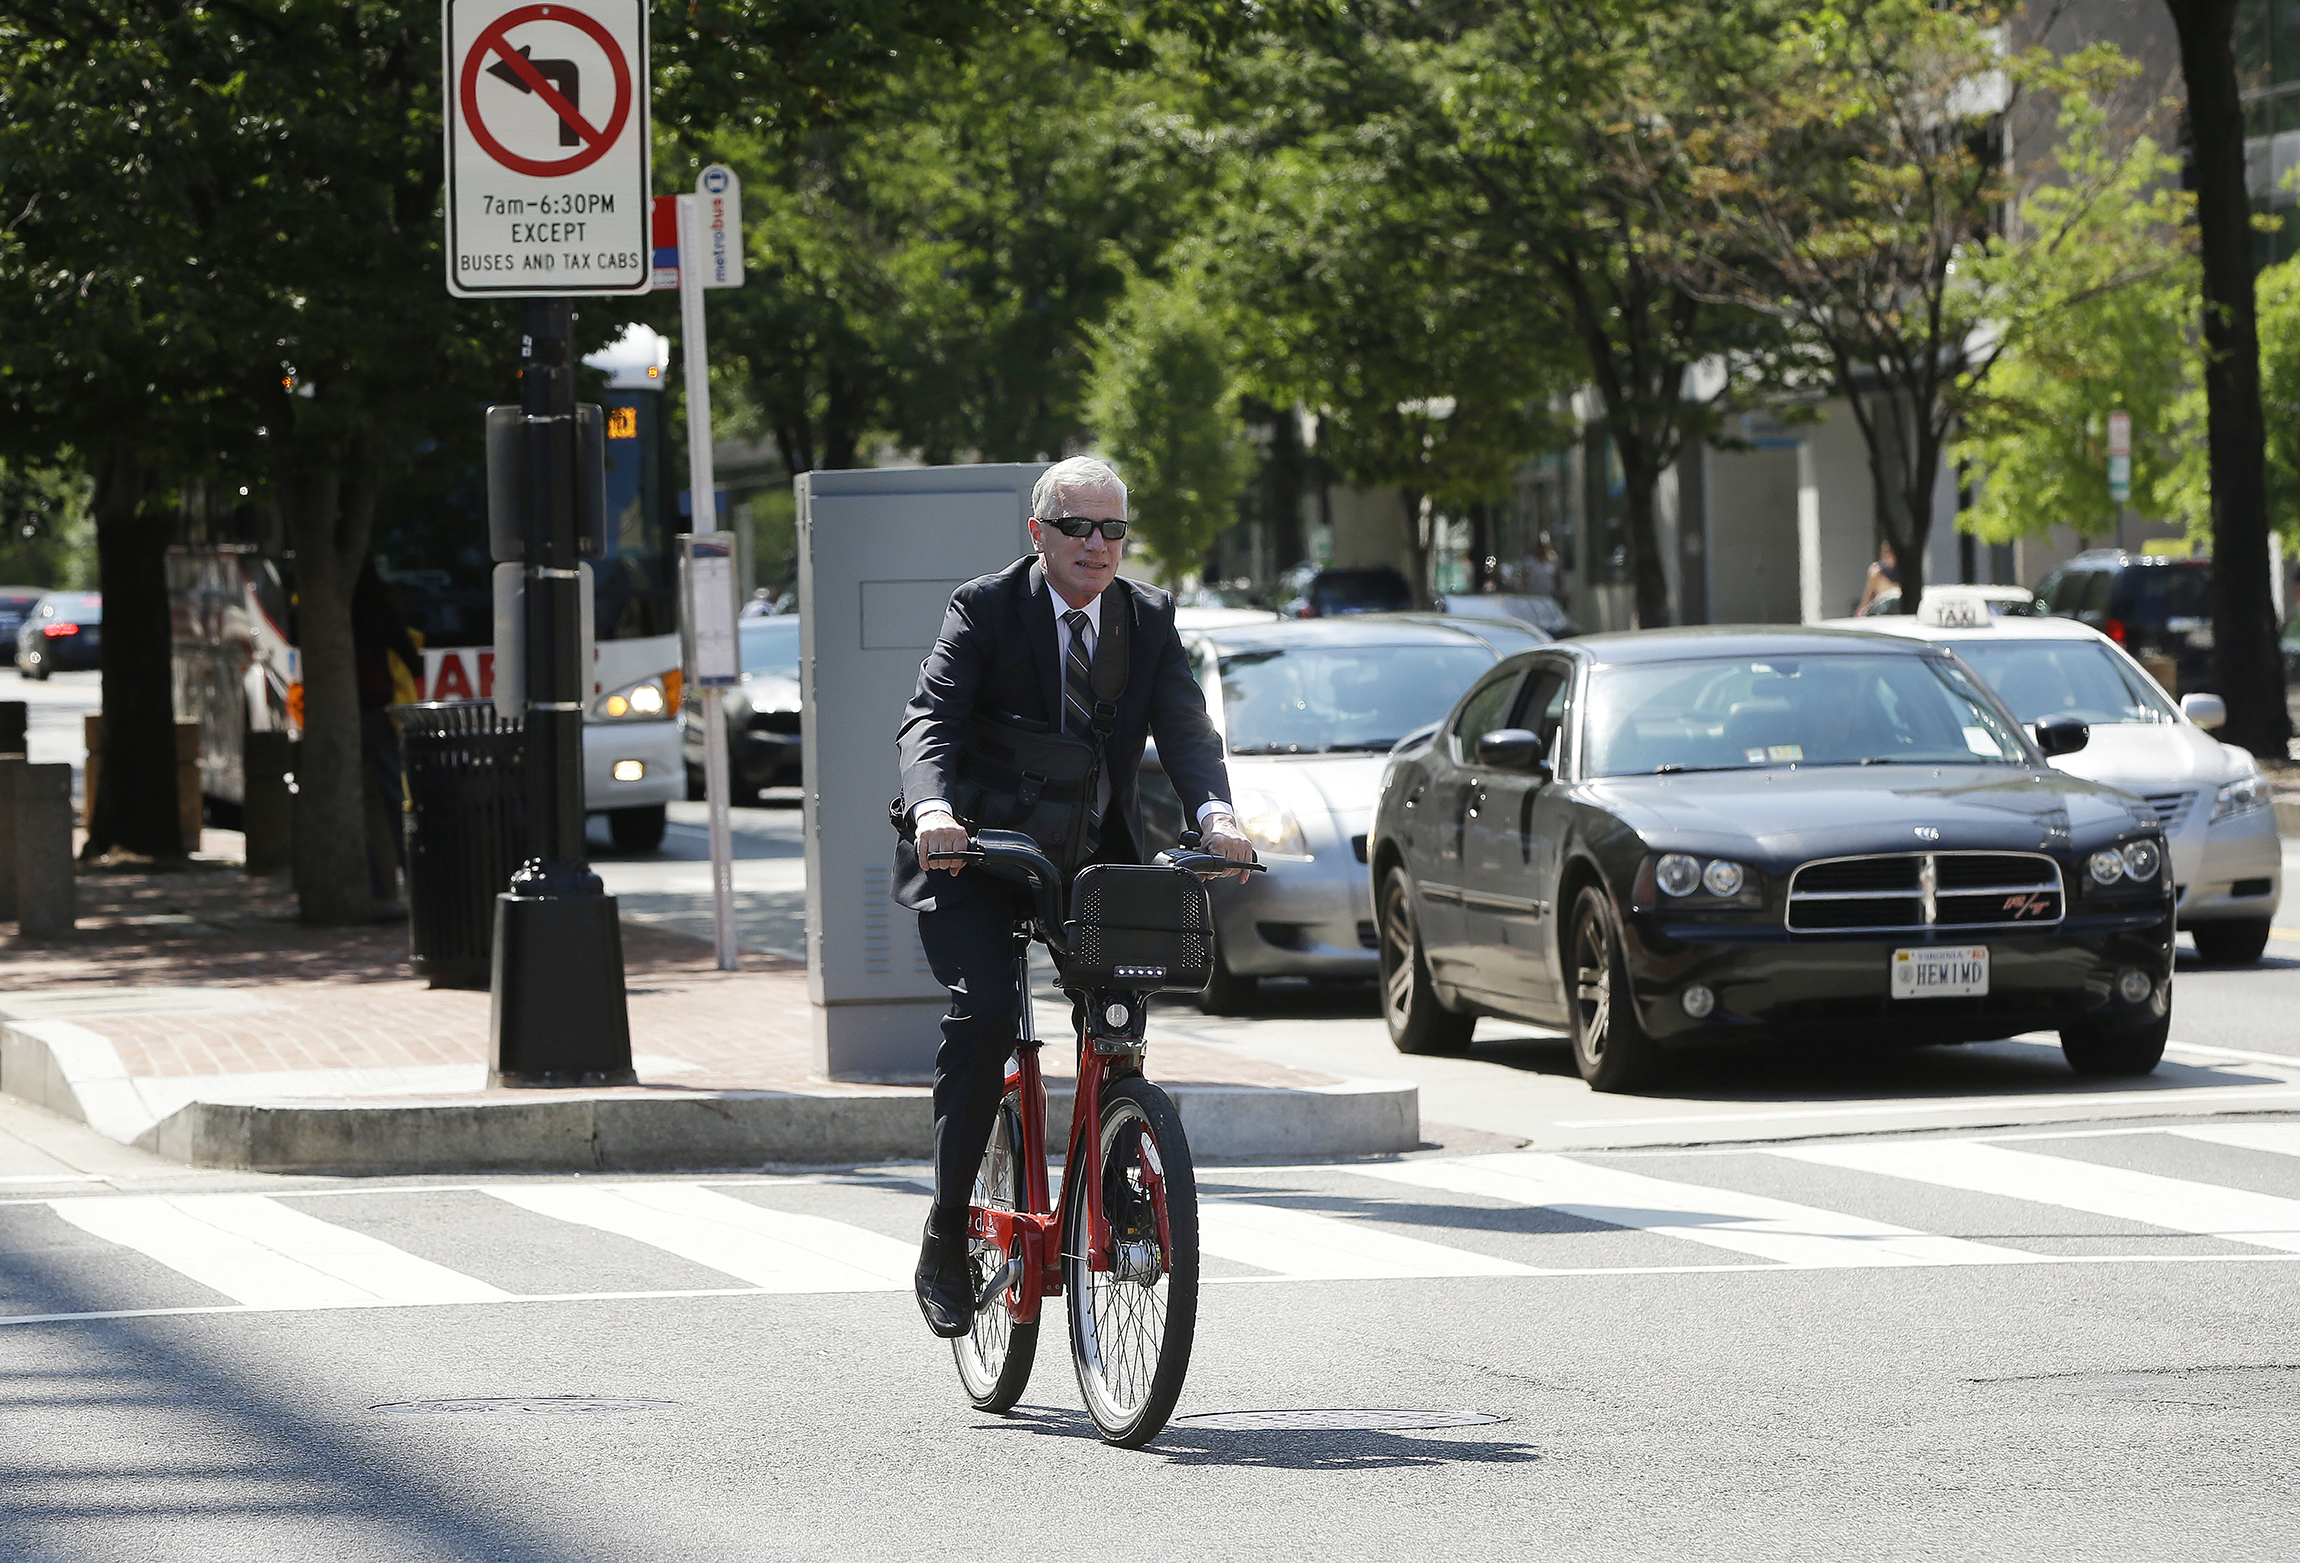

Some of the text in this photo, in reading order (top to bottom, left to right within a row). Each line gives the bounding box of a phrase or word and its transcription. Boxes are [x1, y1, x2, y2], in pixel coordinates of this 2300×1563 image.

[483, 194, 615, 215] 7am-6:30PM
[512, 222, 586, 243] EXCEPT
[711, 197, 726, 282] metrobus
[461, 253, 640, 271] BUSES AND TAX CABS
[1936, 608, 1977, 626] TAXI
[2002, 892, 2051, 919] R/T
[1917, 961, 1982, 986] HEMIMD
